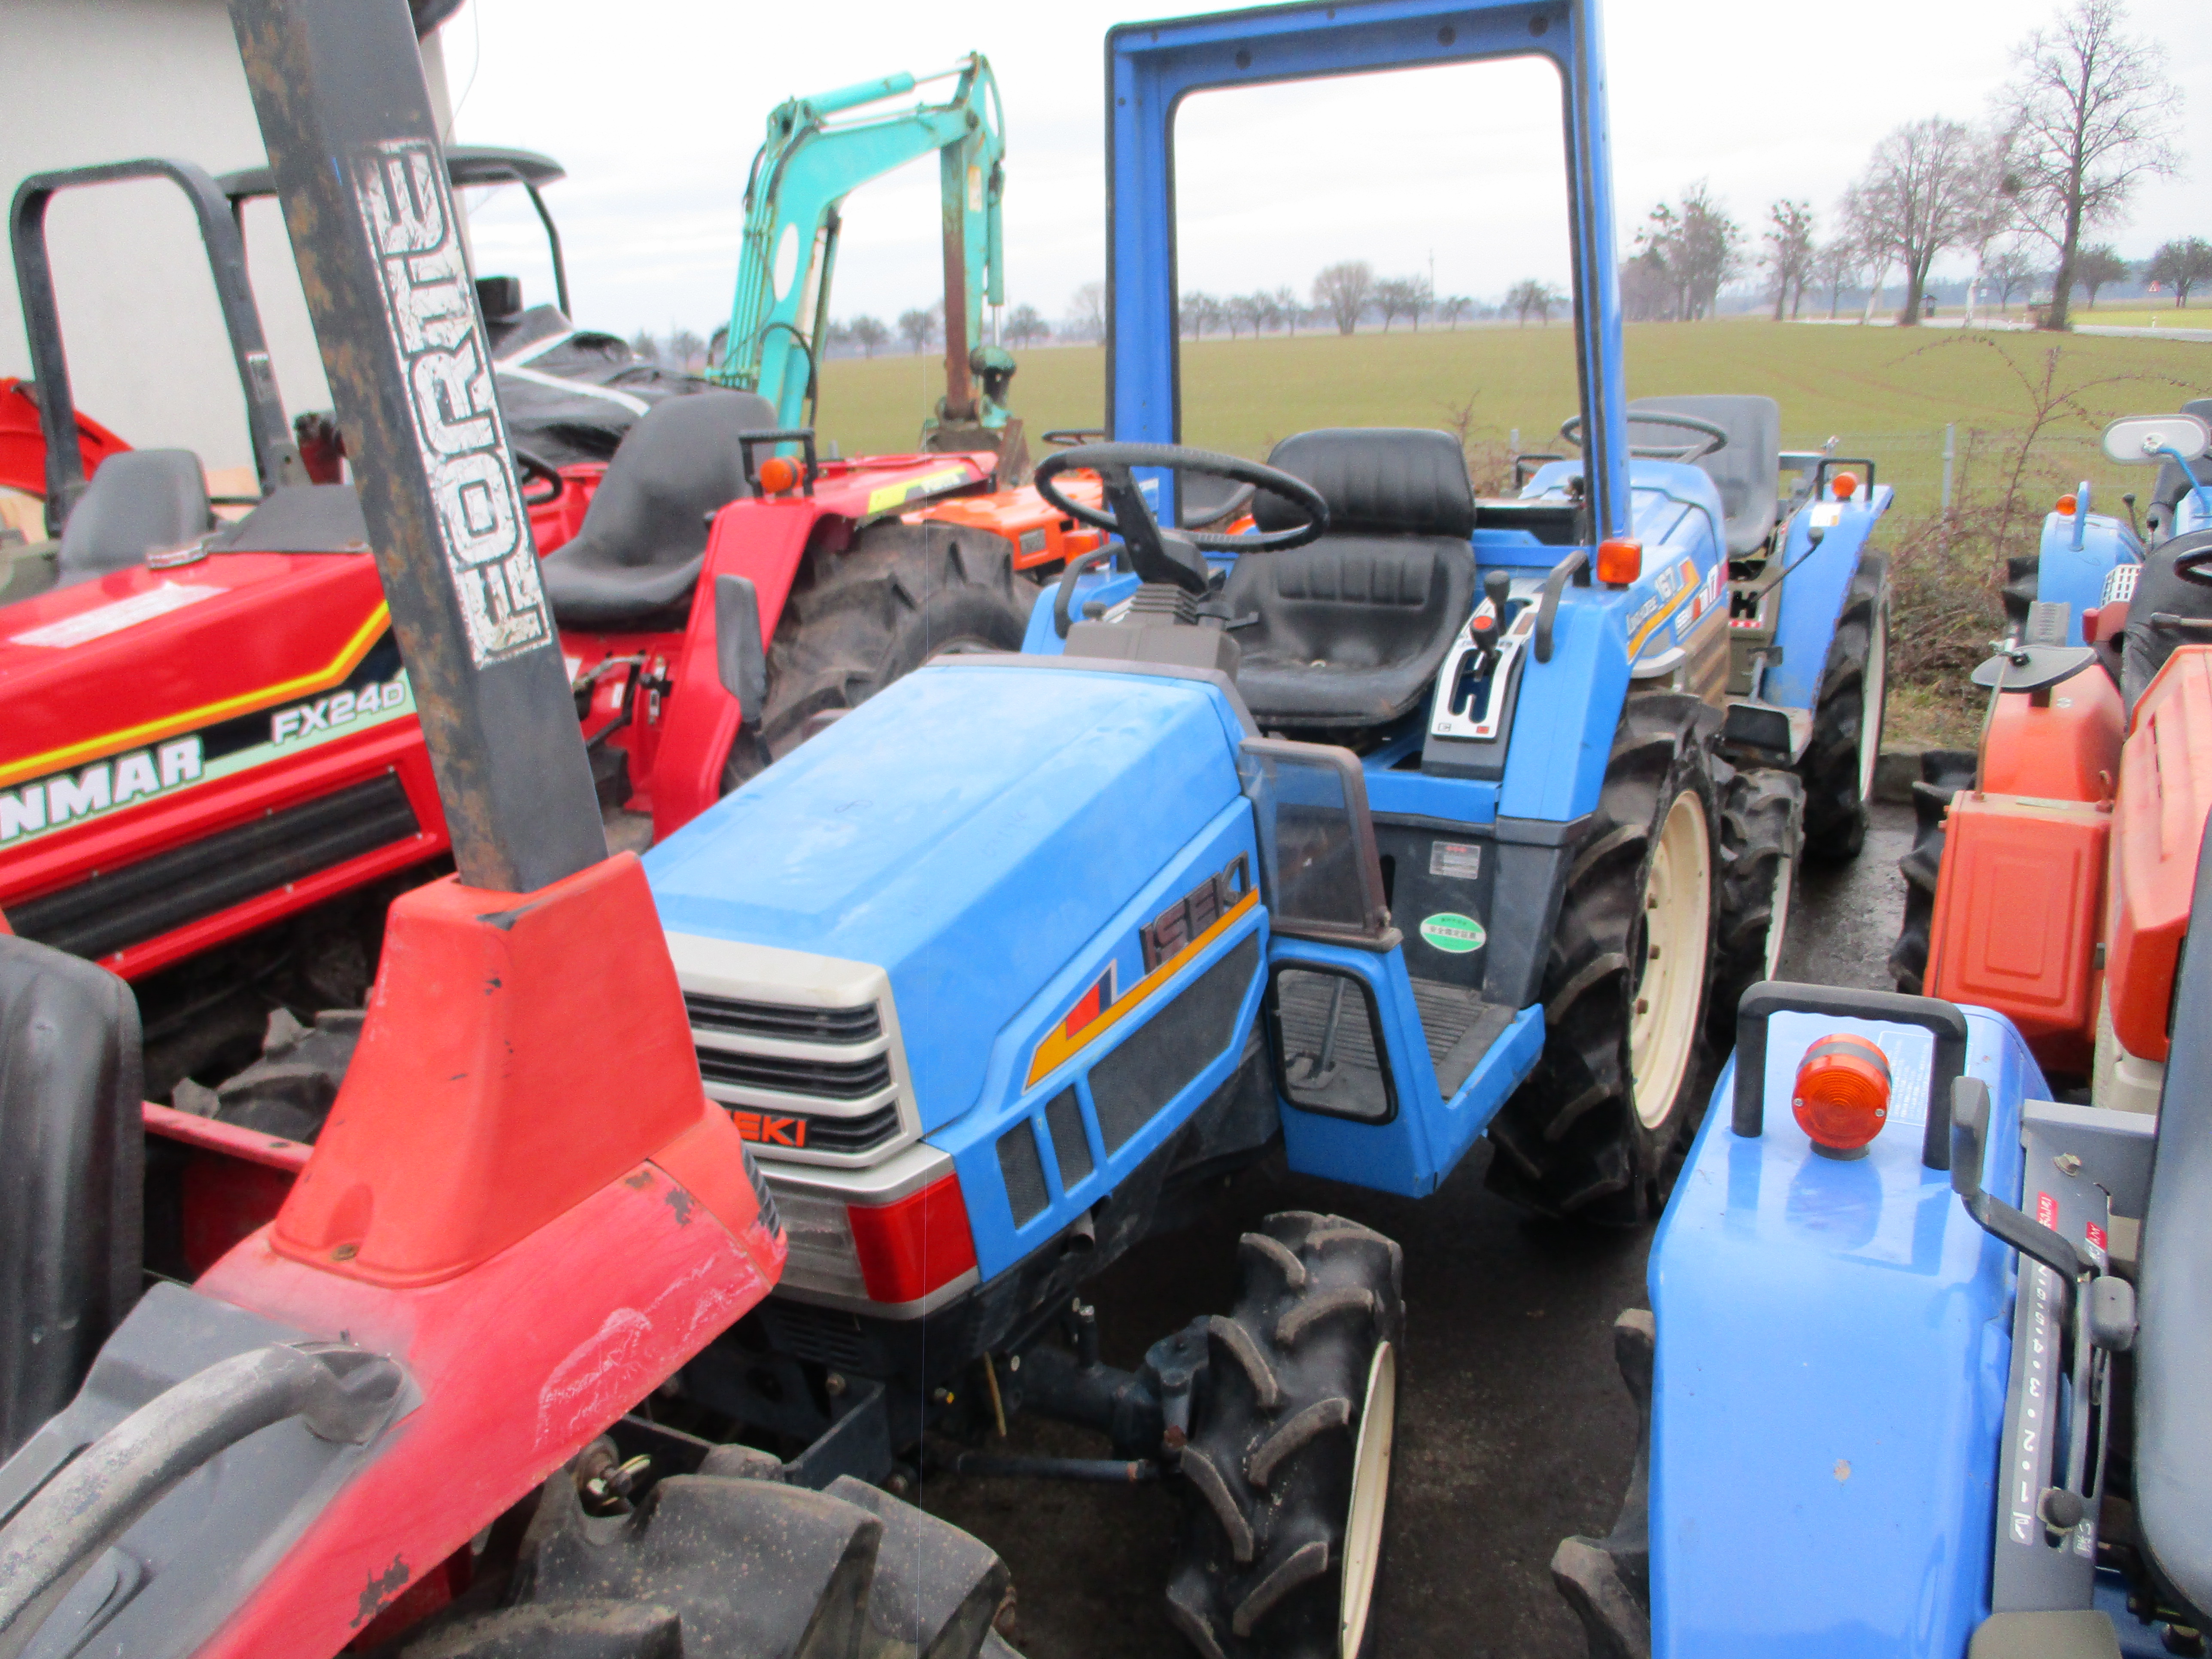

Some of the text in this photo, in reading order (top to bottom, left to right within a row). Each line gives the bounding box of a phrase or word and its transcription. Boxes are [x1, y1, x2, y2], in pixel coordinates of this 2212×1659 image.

[361, 142, 553, 657] FORTE
[271, 682, 406, 745] FX24D
[726, 1109, 806, 1148] EKI
